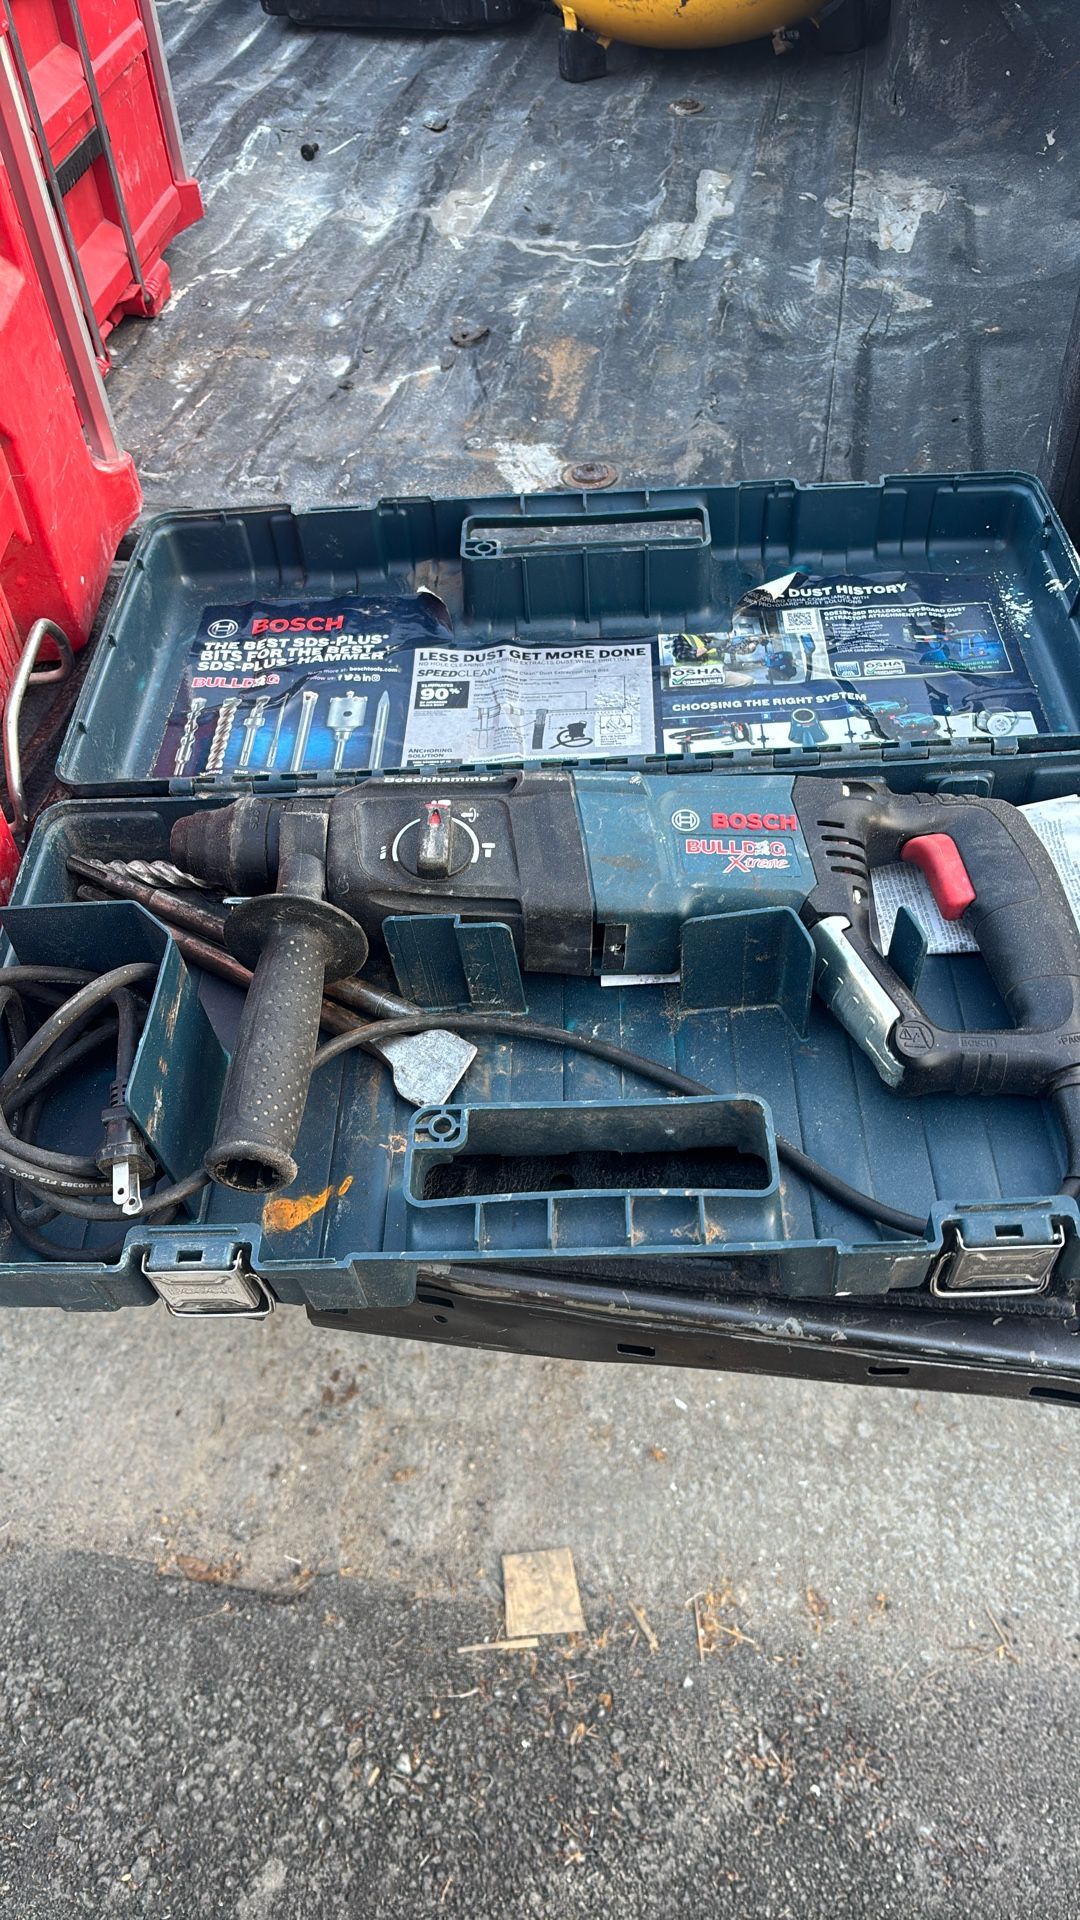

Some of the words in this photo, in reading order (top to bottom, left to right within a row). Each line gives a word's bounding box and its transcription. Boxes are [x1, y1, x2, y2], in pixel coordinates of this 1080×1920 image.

[788, 587, 832, 598] DUST
[835, 583, 907, 596] HISTORY
[252, 616, 344, 634] BOSCH
[204, 641, 240, 650] THE
[243, 638, 290, 651] BEST
[200, 650, 242, 661] BITS
[246, 648, 283, 662] FOR
[287, 647, 323, 657] THE
[325, 644, 375, 654] BEST
[297, 651, 384, 665] HAMMER
[419, 652, 459, 662] LESS
[463, 649, 506, 663] DUST
[509, 649, 542, 661] GET
[545, 649, 595, 661] MORE
[599, 647, 646, 658] DONE
[672, 668, 722, 677] OSHA
[672, 700, 742, 711] CHOOSING
[743, 698, 771, 708] THE
[772, 695, 814, 706] RIGHT
[815, 691, 868, 704] SYSTEM
[712, 813, 797, 830] BOSCH
